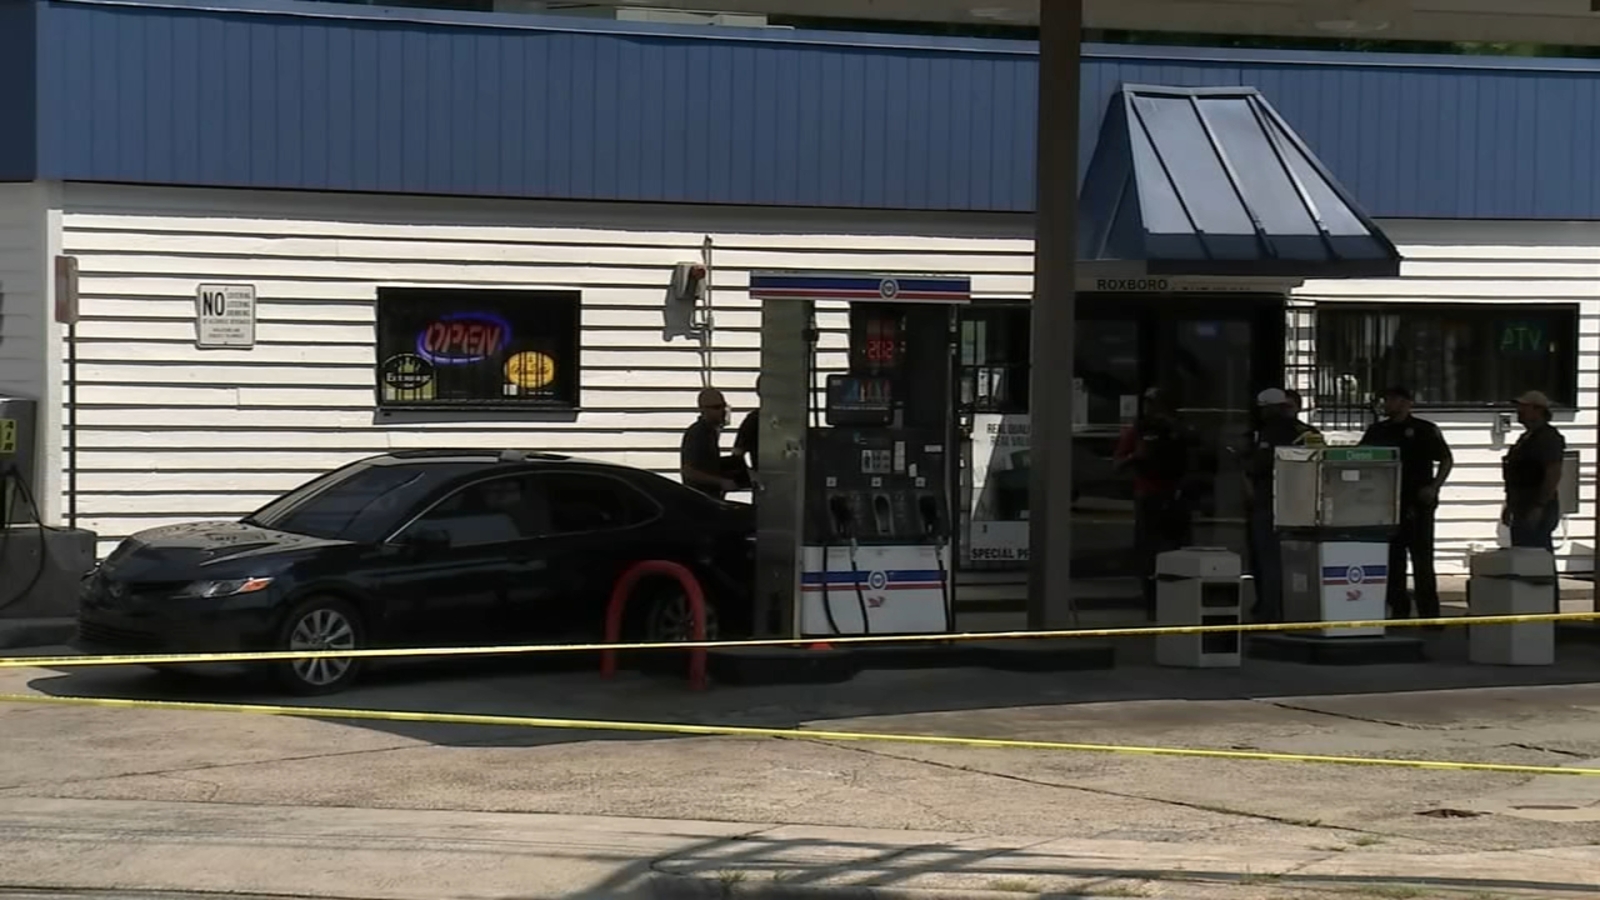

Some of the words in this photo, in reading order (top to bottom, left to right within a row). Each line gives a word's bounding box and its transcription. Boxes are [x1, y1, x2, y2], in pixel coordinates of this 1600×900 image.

[1096, 279, 1168, 290] ROXBORO
[203, 292, 225, 316] NO
[424, 321, 500, 356] OPEN
[972, 547, 1014, 559] SPECIAL
